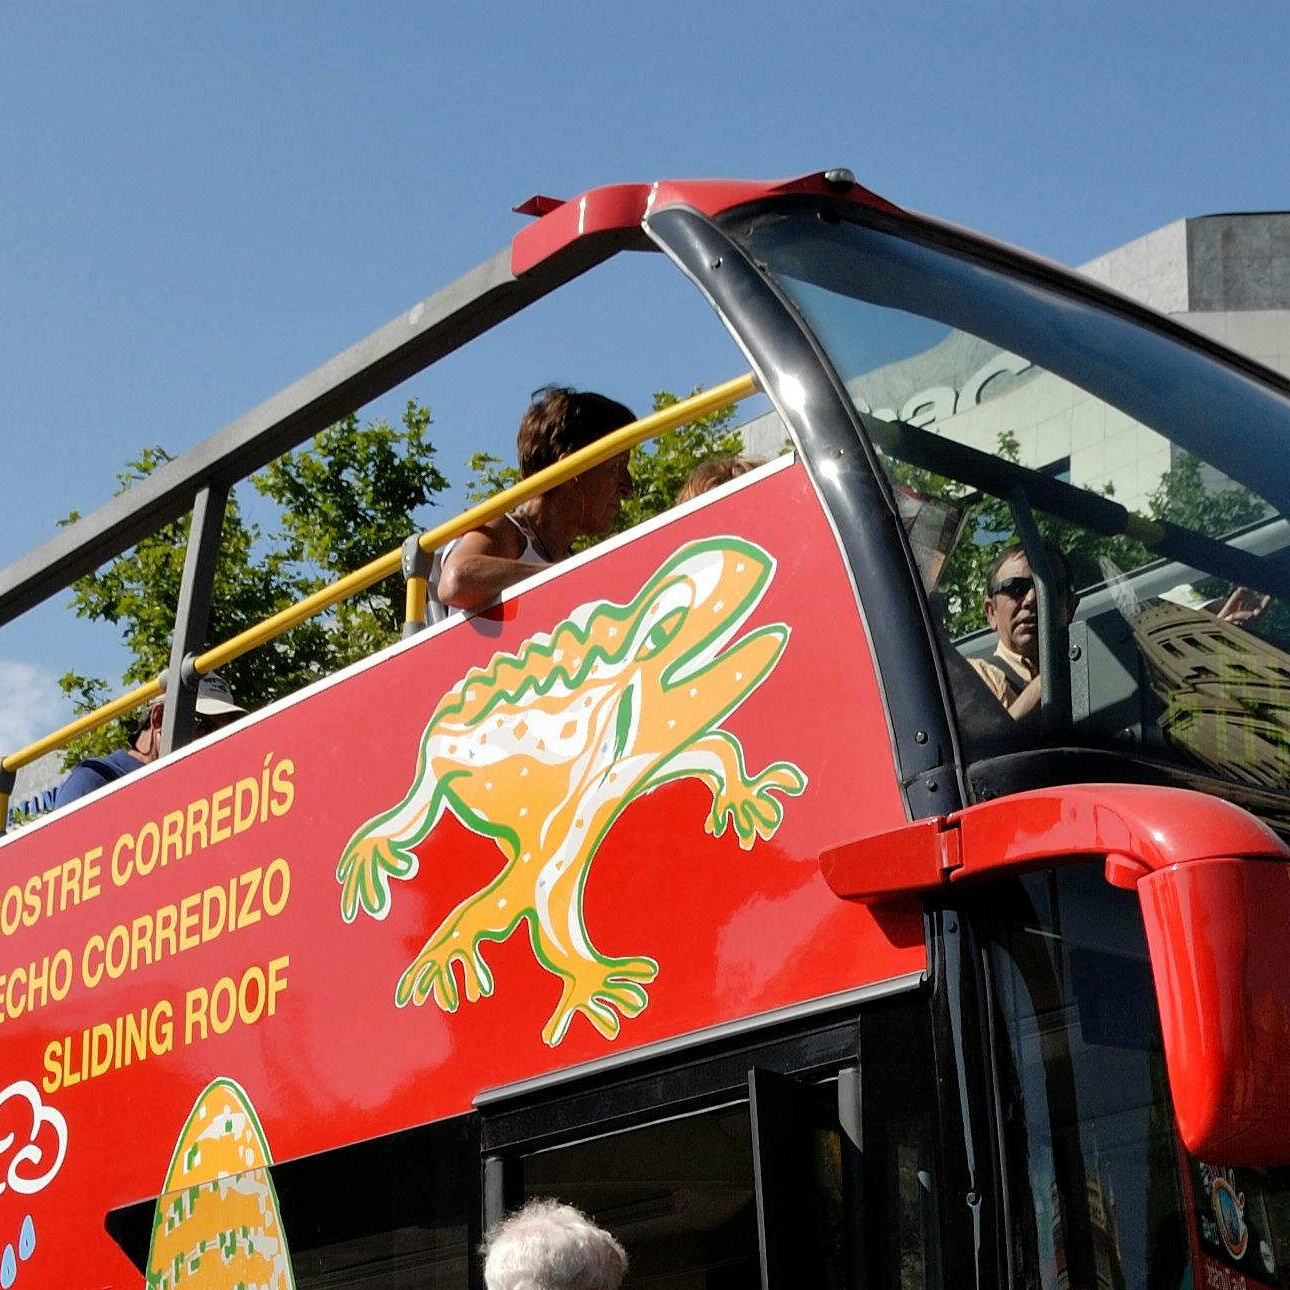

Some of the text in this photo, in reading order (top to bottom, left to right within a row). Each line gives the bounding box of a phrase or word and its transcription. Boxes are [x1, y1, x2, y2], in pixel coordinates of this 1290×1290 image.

[110, 752, 296, 889] CORREDÍS
[81, 858, 291, 990] CORREDIZO
[42, 956, 290, 1094] SLIDING ROOF
